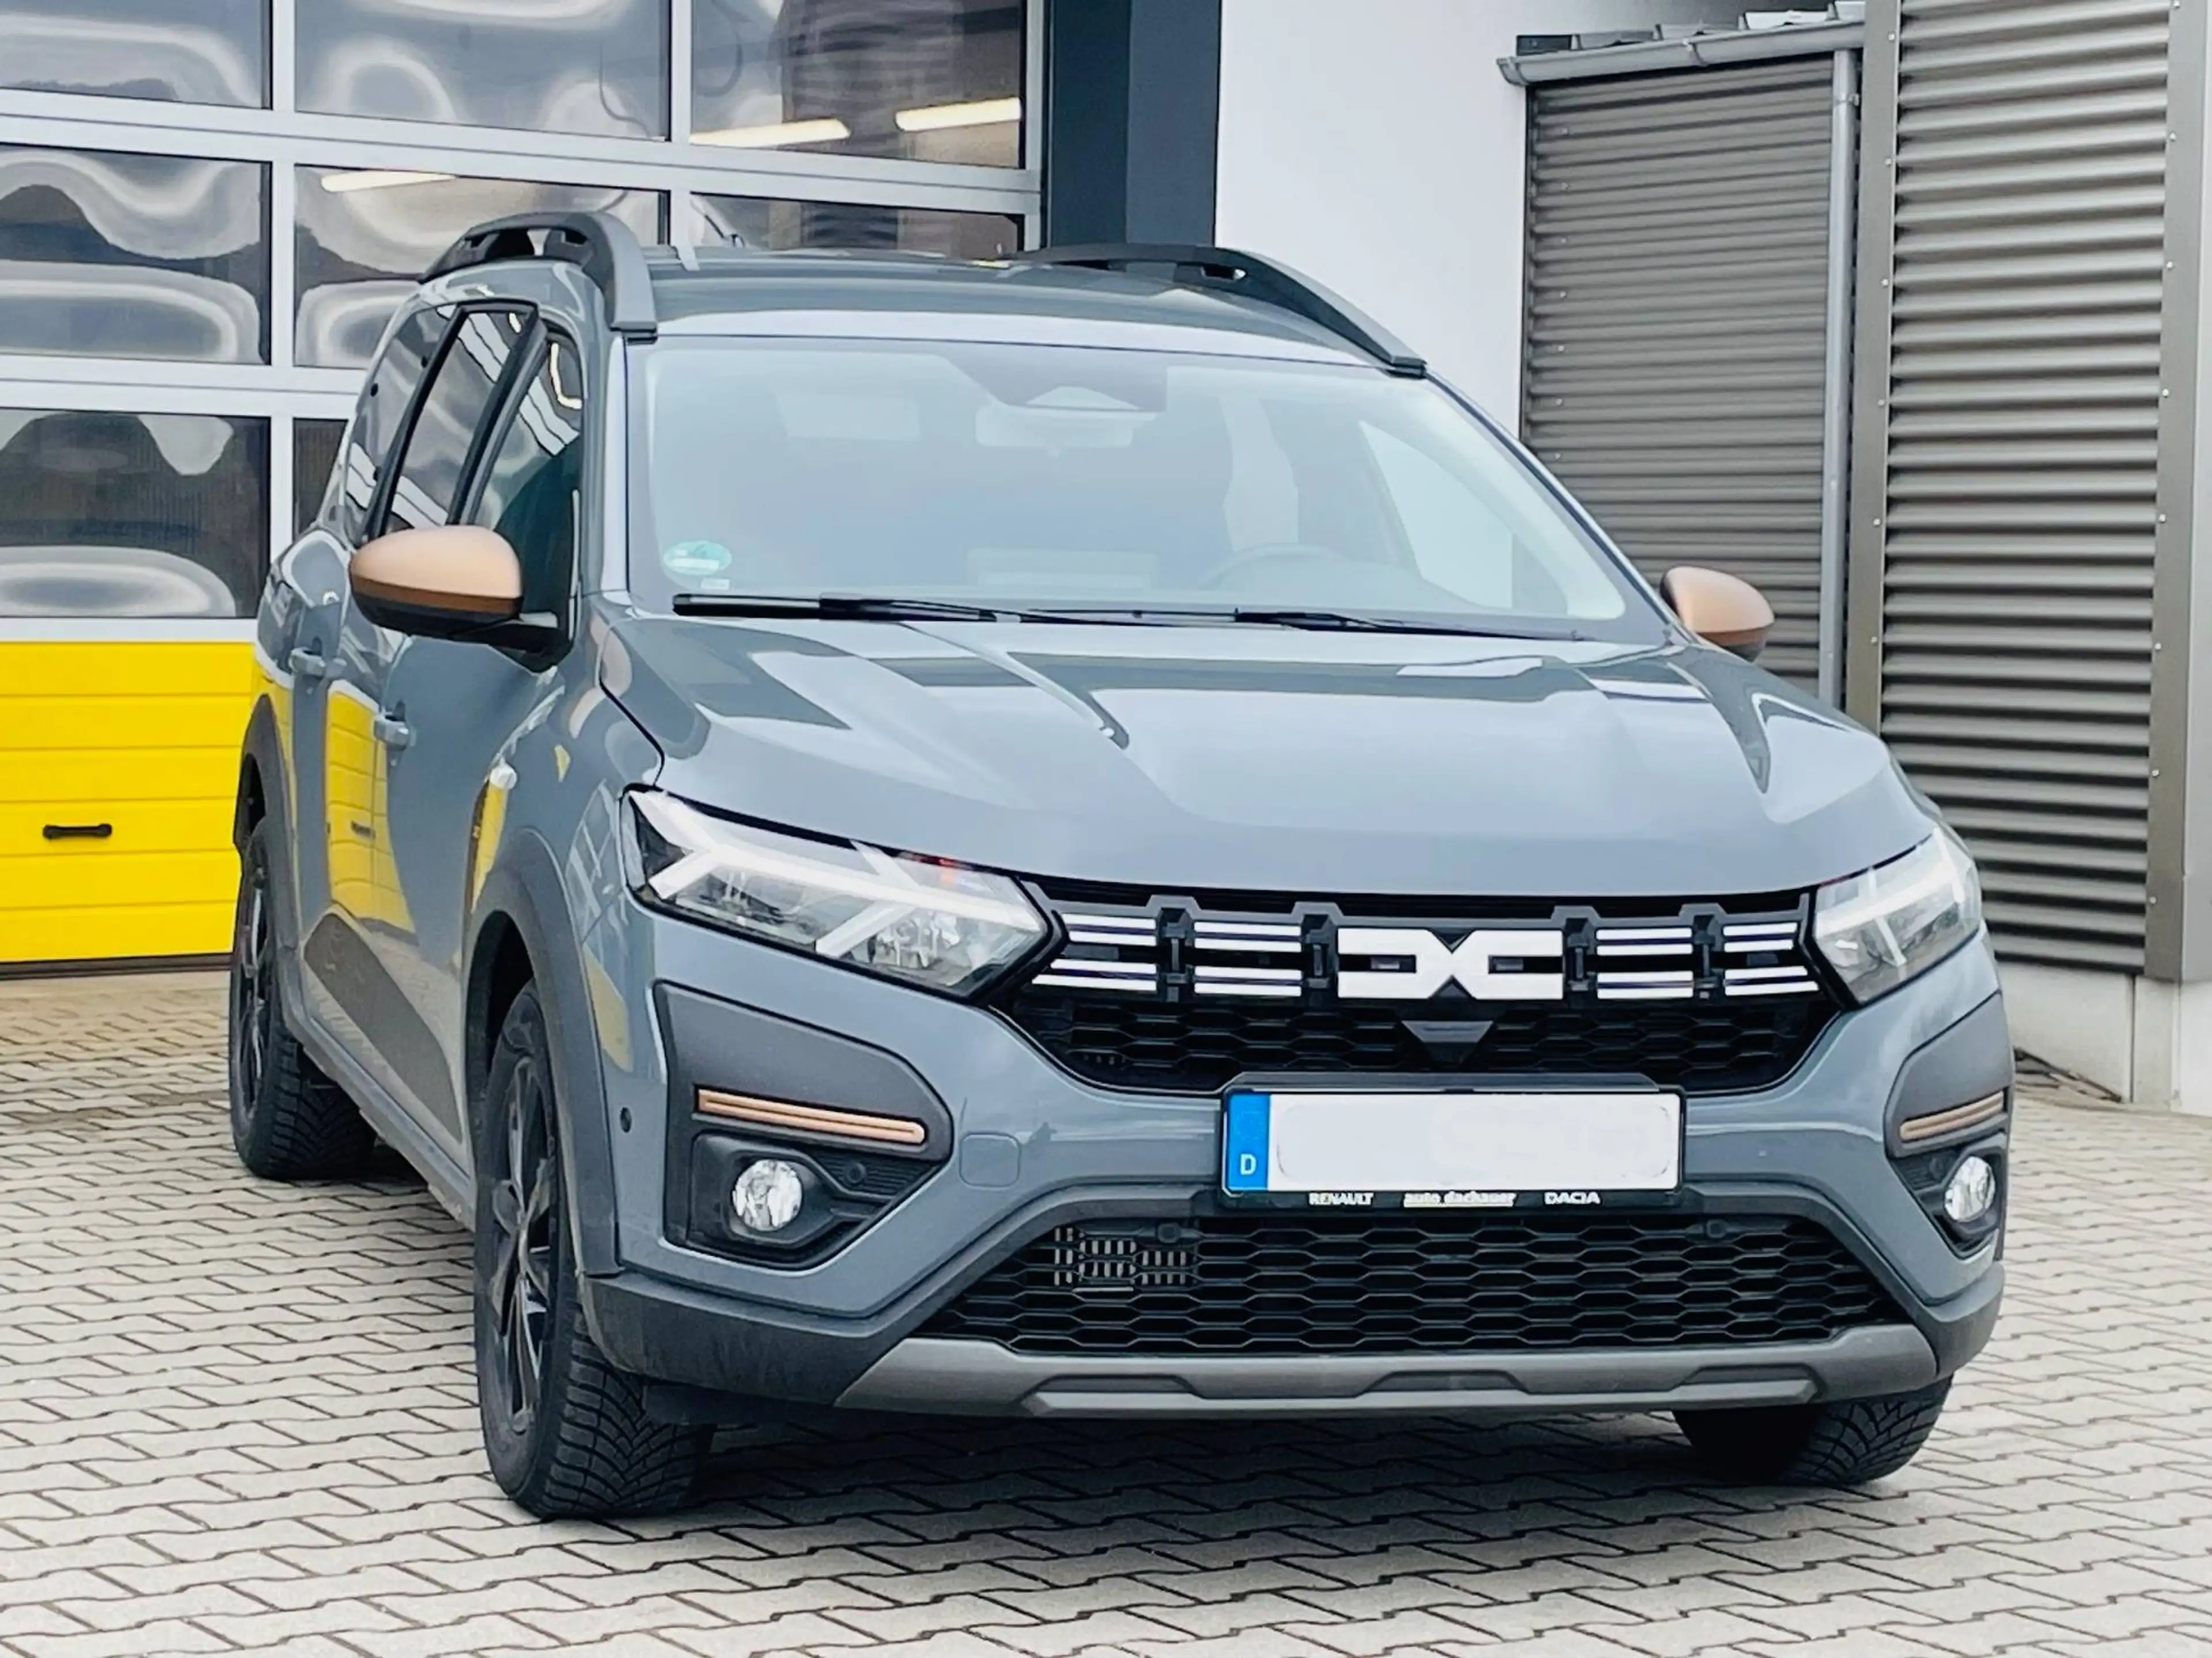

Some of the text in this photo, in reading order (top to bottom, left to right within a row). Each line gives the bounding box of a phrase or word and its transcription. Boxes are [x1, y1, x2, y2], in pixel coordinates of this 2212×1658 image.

[1240, 1154, 1256, 1175] D
[1309, 1192, 1373, 1205] RENAULT
[1544, 1192, 1601, 1205] DACIA
